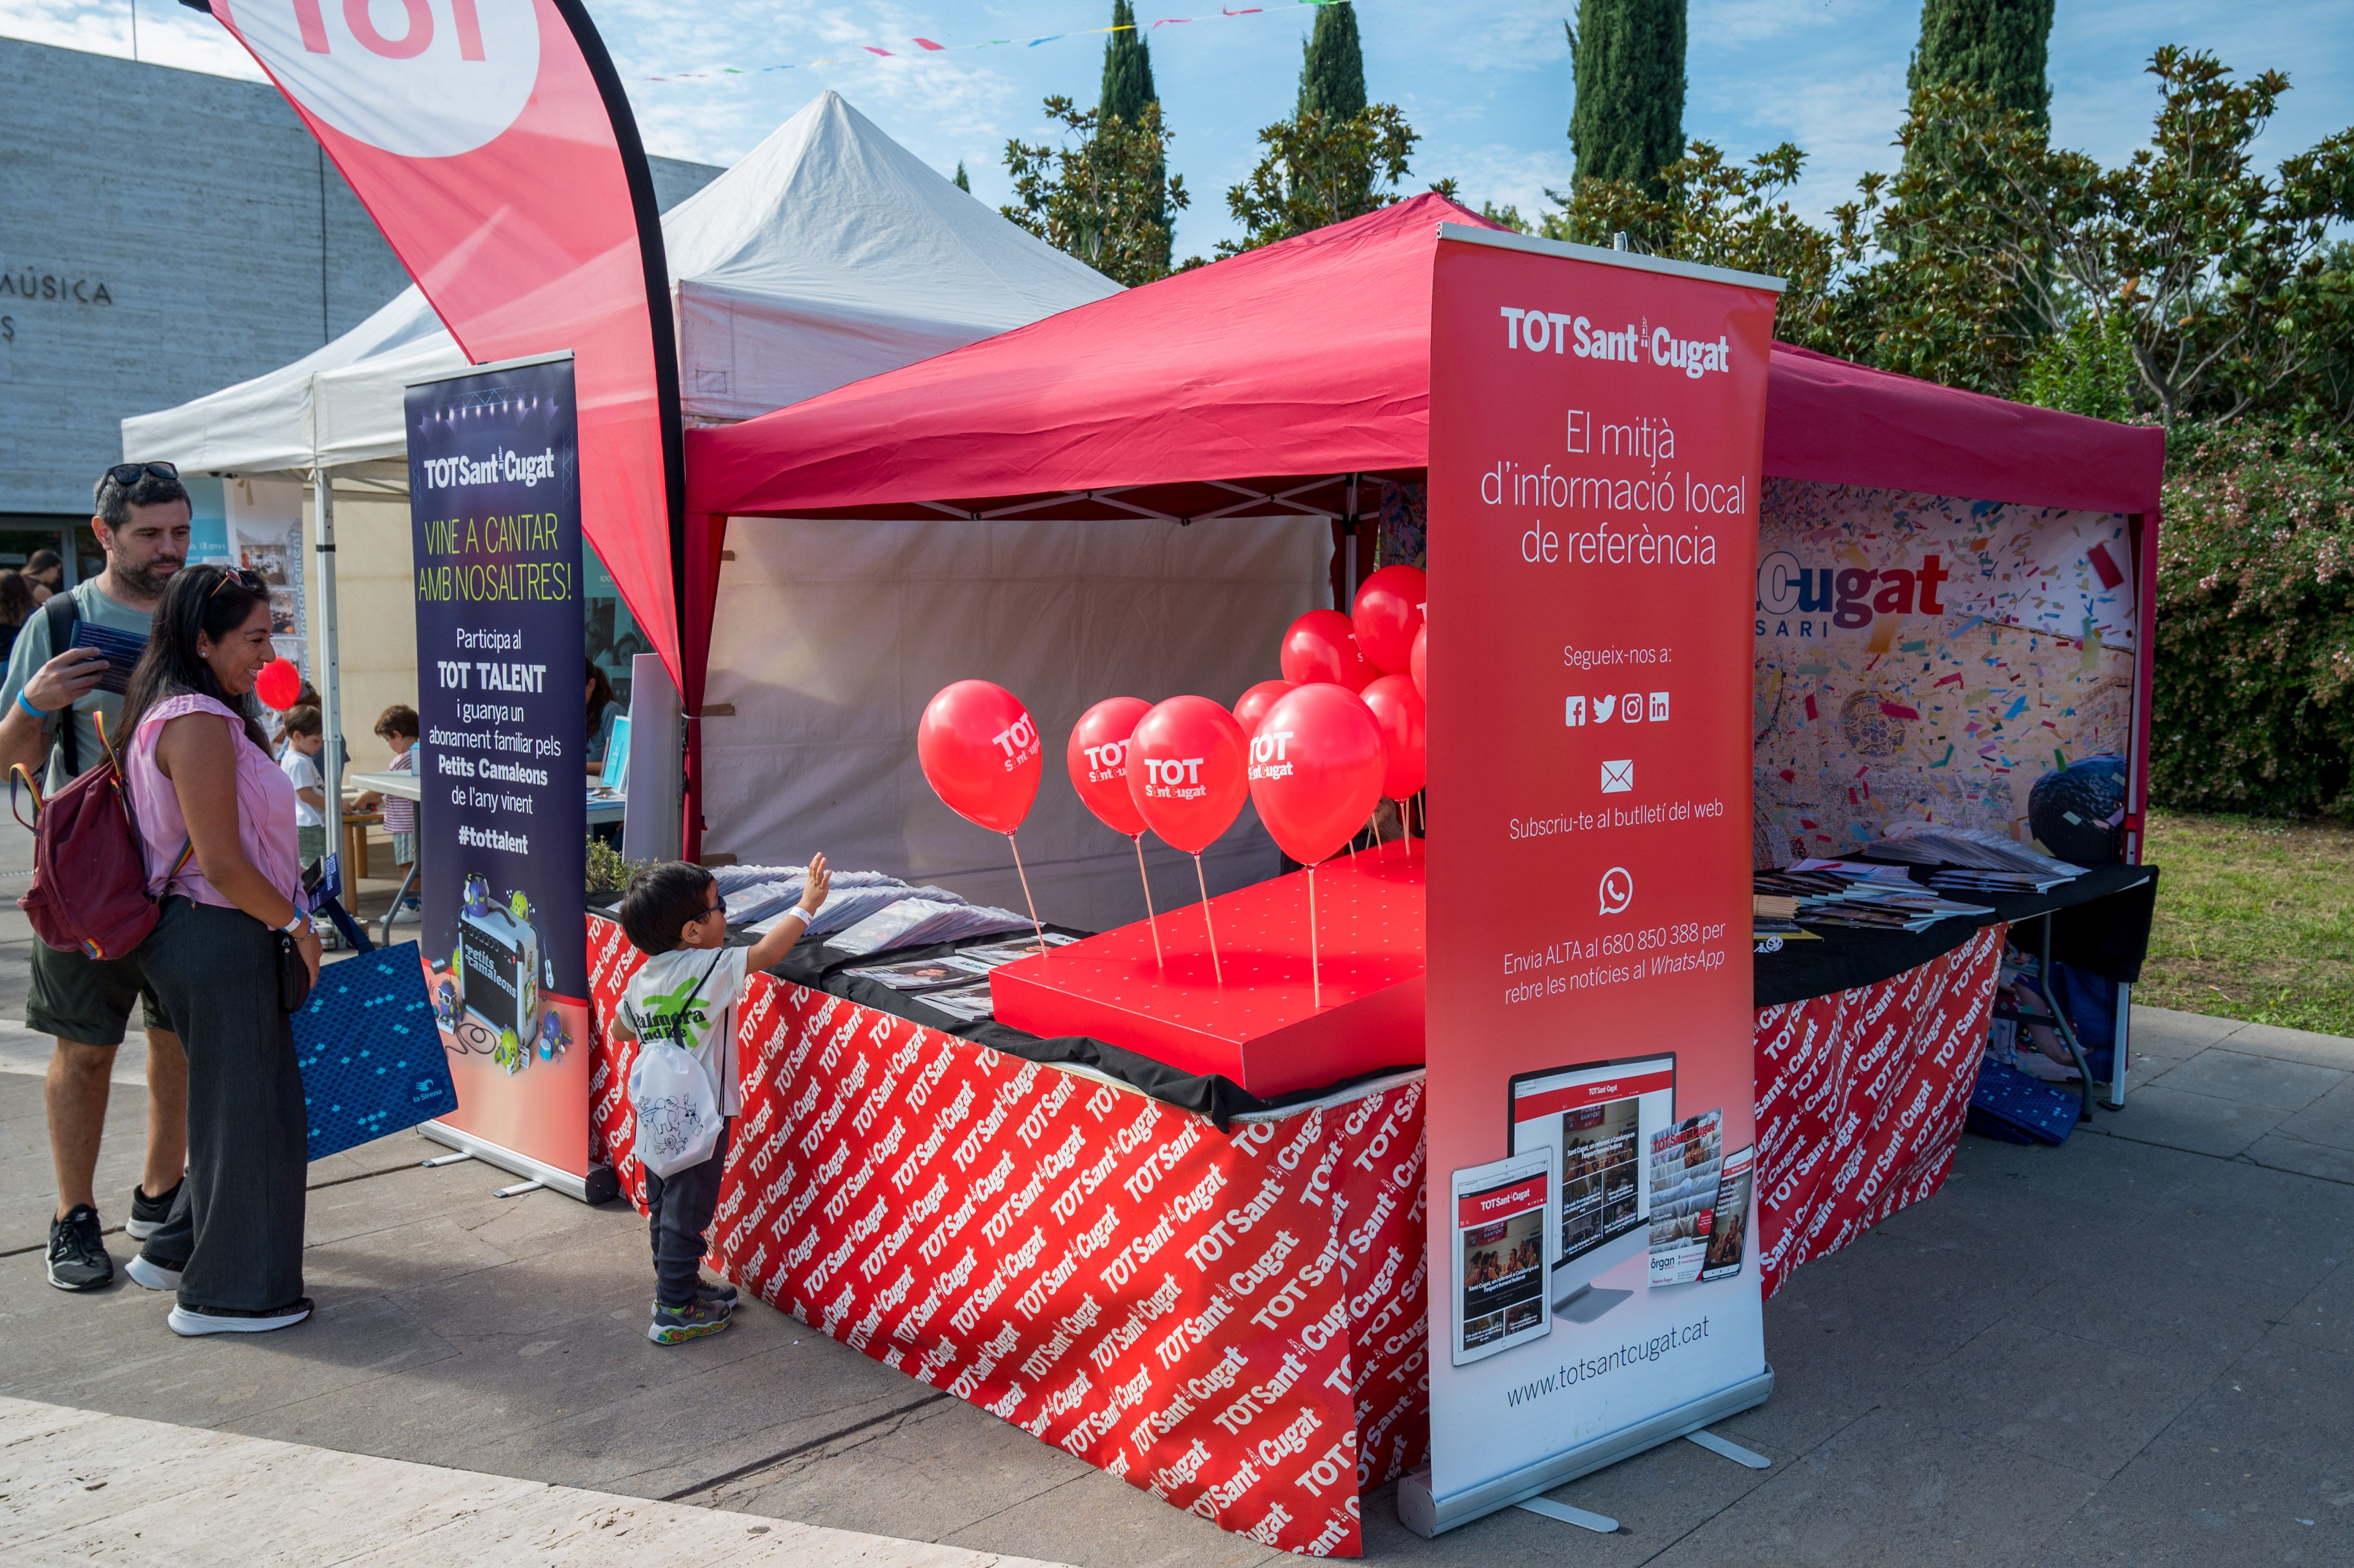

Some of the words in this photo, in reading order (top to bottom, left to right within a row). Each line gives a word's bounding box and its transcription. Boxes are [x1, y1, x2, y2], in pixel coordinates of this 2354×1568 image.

[1567, 409, 1590, 453] El
[1602, 416, 1675, 468] mitjà
[1686, 472, 1745, 514] local
[425, 519, 460, 555] VINE
[466, 518, 479, 553] A
[485, 513, 558, 553] CANTAR
[1522, 519, 1558, 563] de
[1569, 522, 1716, 565] referència
[419, 566, 451, 601] AMB
[456, 563, 571, 600] NOSALTRES!
[457, 628, 510, 653] Participa
[513, 630, 521, 649] al
[1564, 645, 1656, 671] Segueix-nos
[1659, 647, 1672, 663] a:
[438, 661, 470, 688] TOT
[477, 662, 546, 692] TALENT
[457, 699, 460, 717] i
[463, 704, 508, 725] guanya
[511, 707, 524, 722] un
[429, 725, 490, 749] abonament
[494, 732, 533, 753] familiar
[536, 736, 561, 759] pels
[992, 712, 1036, 757] TOT
[1250, 731, 1293, 765] TOT
[439, 754, 474, 777] Petits
[479, 758, 548, 786] Camaleons
[1084, 738, 1131, 770] TOT
[1144, 758, 1204, 785] TOT
[452, 786, 465, 805] de
[469, 787, 498, 813] l'any
[501, 791, 533, 814] vinent
[1510, 811, 1593, 840] Subscriu-te
[1598, 807, 1610, 829] al
[1615, 802, 1666, 827] butlletí
[1668, 801, 1690, 820] del
[1694, 798, 1724, 819] web
[459, 826, 528, 855] #tottalent
[1505, 951, 1542, 975] Envia
[1546, 940, 1582, 969] ALTA
[1586, 938, 1599, 959] al
[1602, 933, 1634, 954] 680
[1638, 927, 1667, 950] 850
[1670, 922, 1699, 945] 388
[1702, 921, 1725, 943] per
[1505, 979, 1542, 1004] rebre
[1547, 971, 1566, 996] les
[1570, 966, 1629, 992] notícies
[1633, 960, 1645, 979] al
[1651, 948, 1725, 976] WhatsApp
[421, 1090, 442, 1100] Sirena
[1567, 1148, 1576, 1157] Sant
[1613, 1133, 1630, 1145] Catalunya
[1497, 1274, 1512, 1283] referent
[1515, 1267, 1534, 1277] Catalunya
[1507, 1315, 1710, 1408] www.totsantcugat.cat
